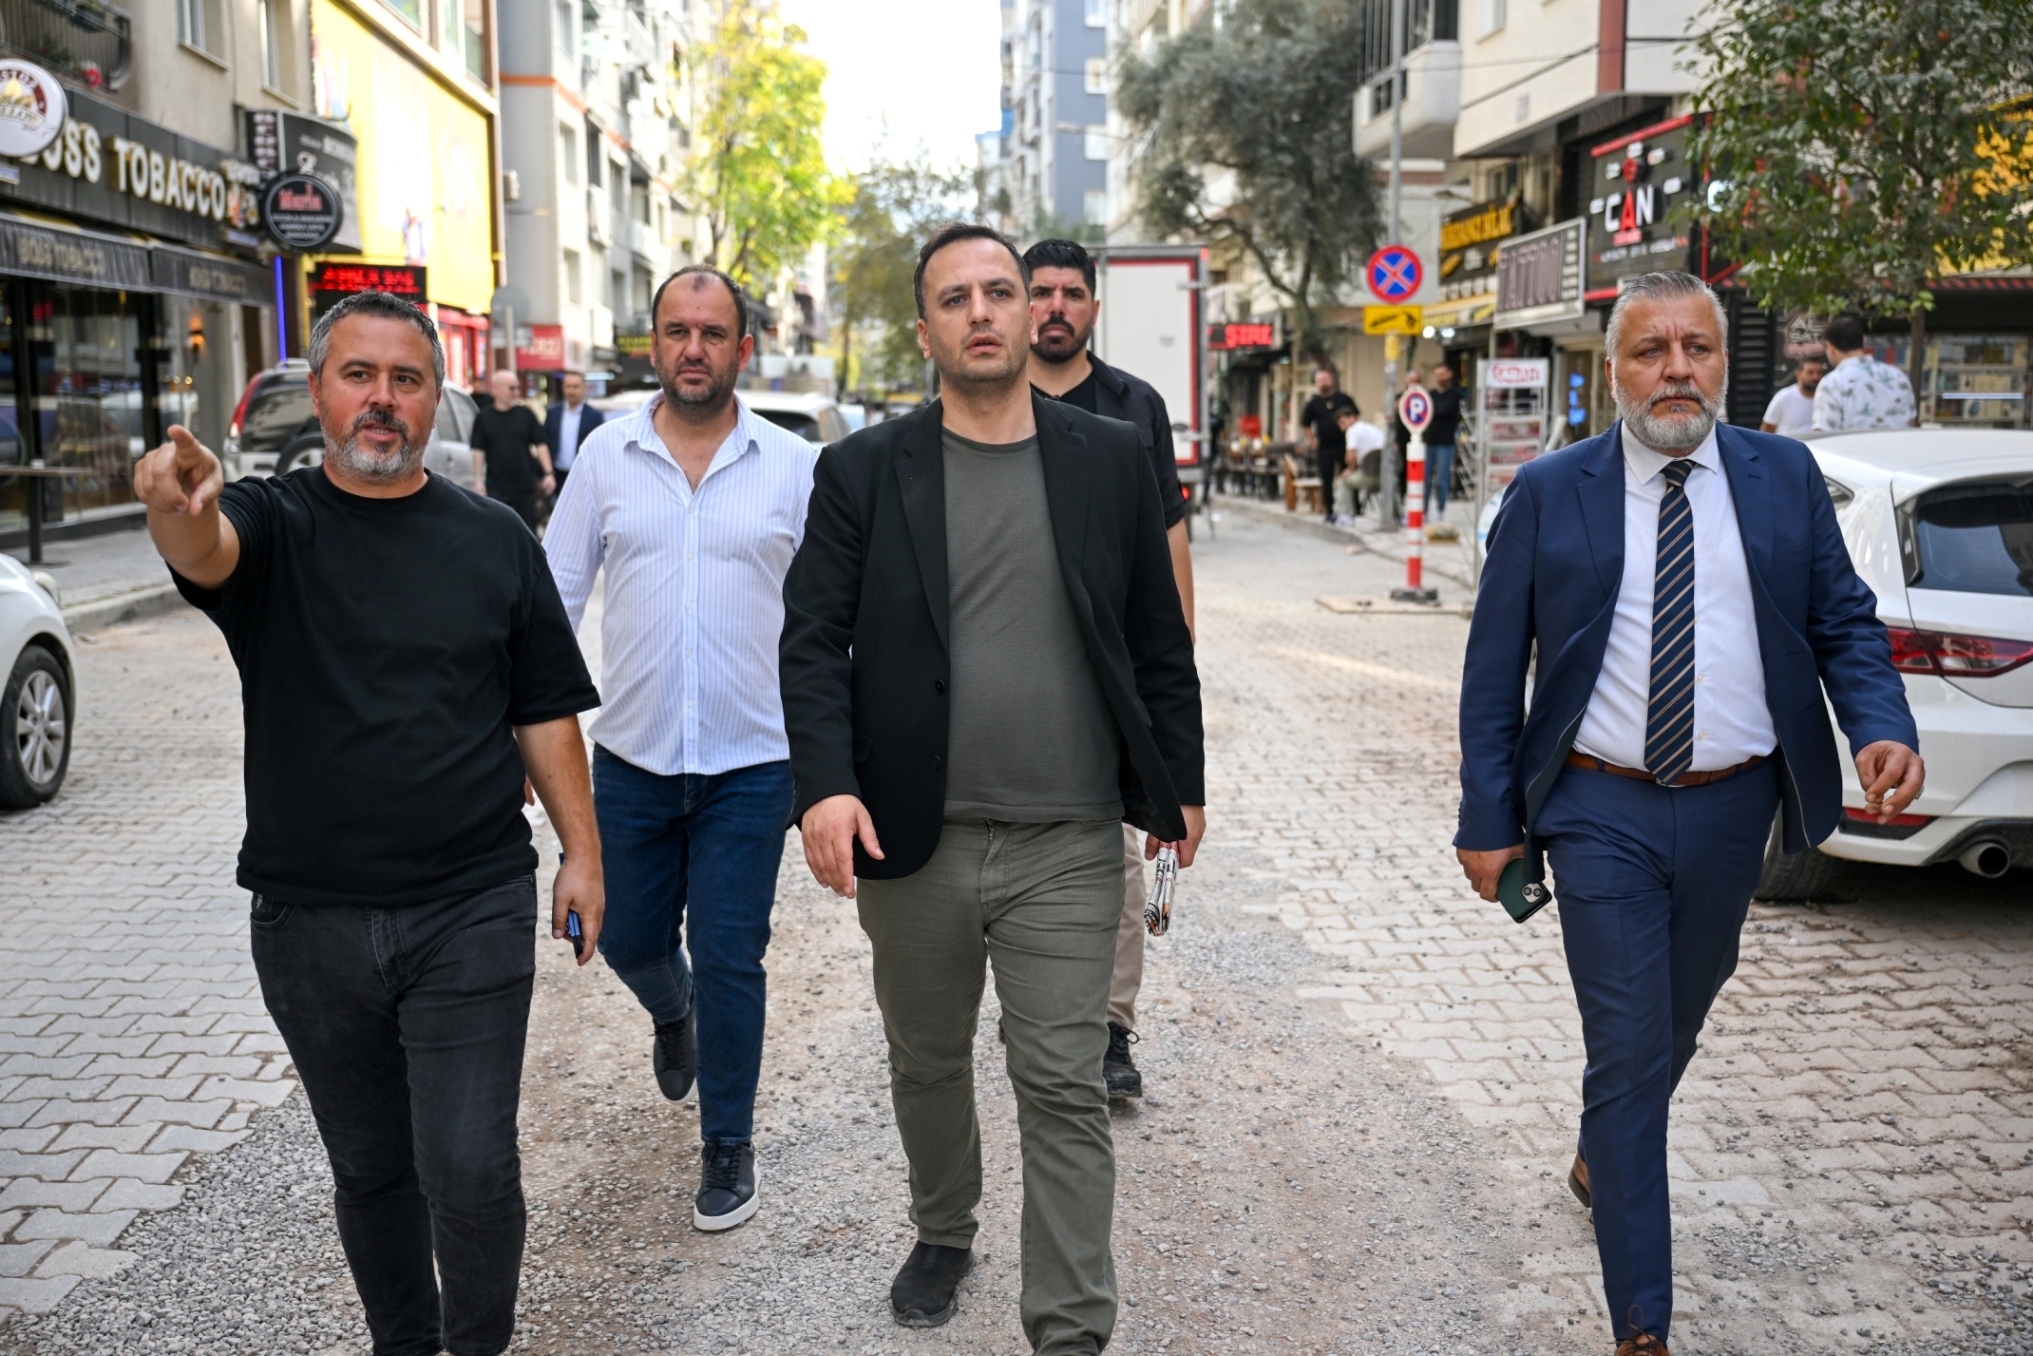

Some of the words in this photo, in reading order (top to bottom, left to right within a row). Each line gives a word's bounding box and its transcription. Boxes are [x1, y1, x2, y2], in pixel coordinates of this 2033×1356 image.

[20, 117, 102, 184] OSS
[110, 136, 226, 222] TOBACCO
[1605, 183, 1655, 232] CAN
[1498, 237, 1560, 312] TATTOO
[1409, 397, 1426, 422] P
